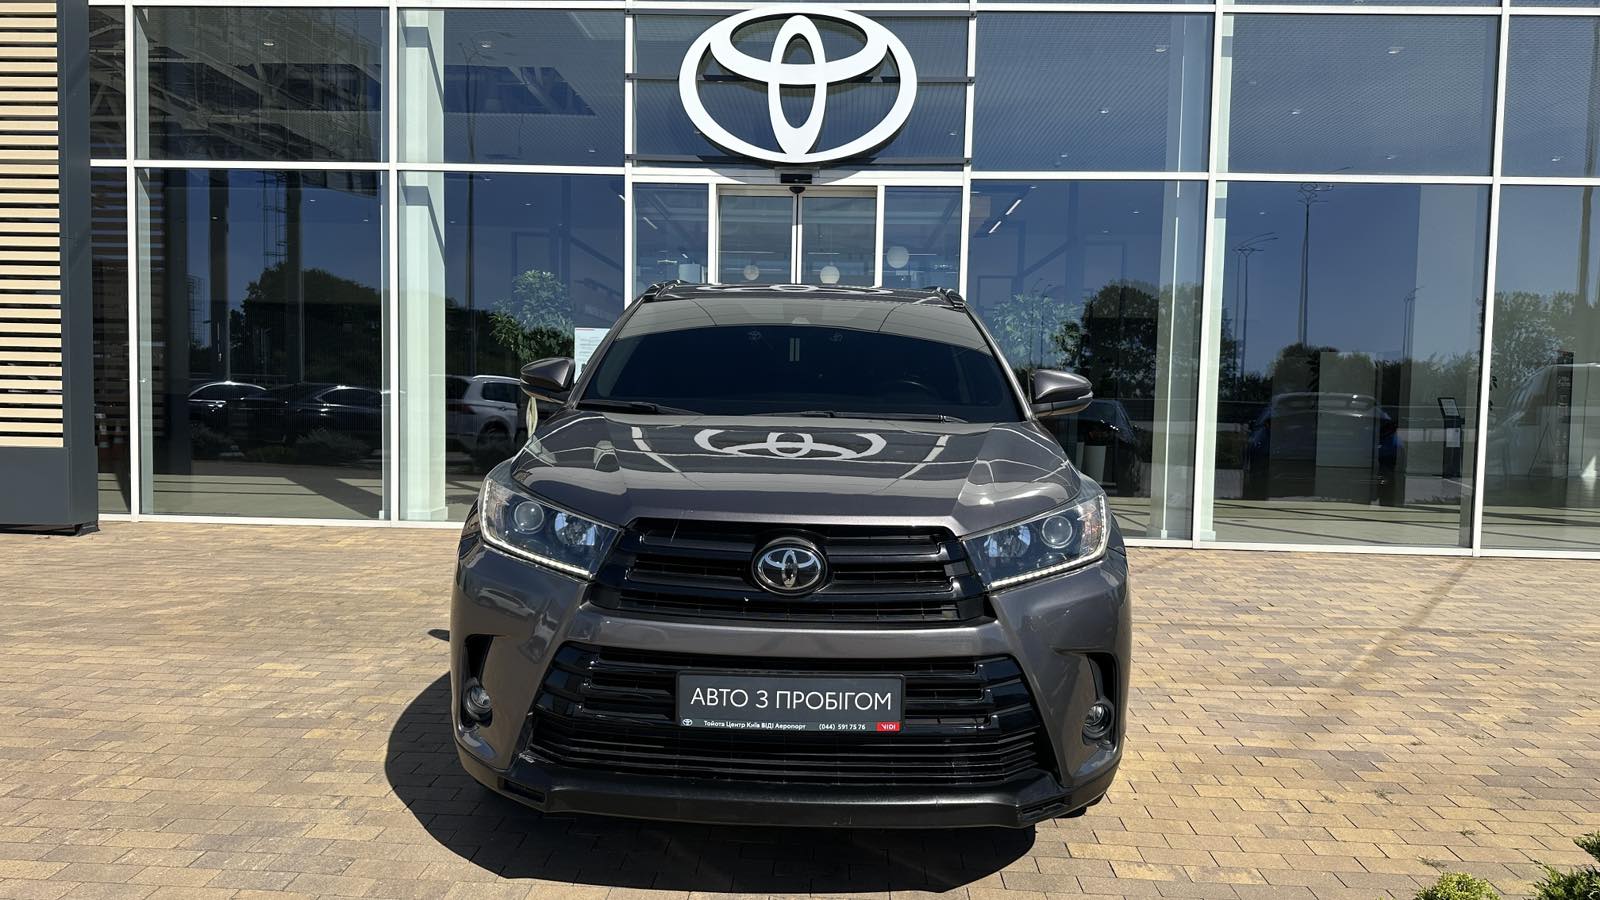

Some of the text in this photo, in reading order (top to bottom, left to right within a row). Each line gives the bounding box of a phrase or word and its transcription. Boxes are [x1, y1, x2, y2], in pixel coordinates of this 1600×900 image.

[691, 688, 892, 710] АВТО З ПРОБІГОМ
[775, 722, 806, 731] Аеропорт
[818, 723, 836, 731] (044)
